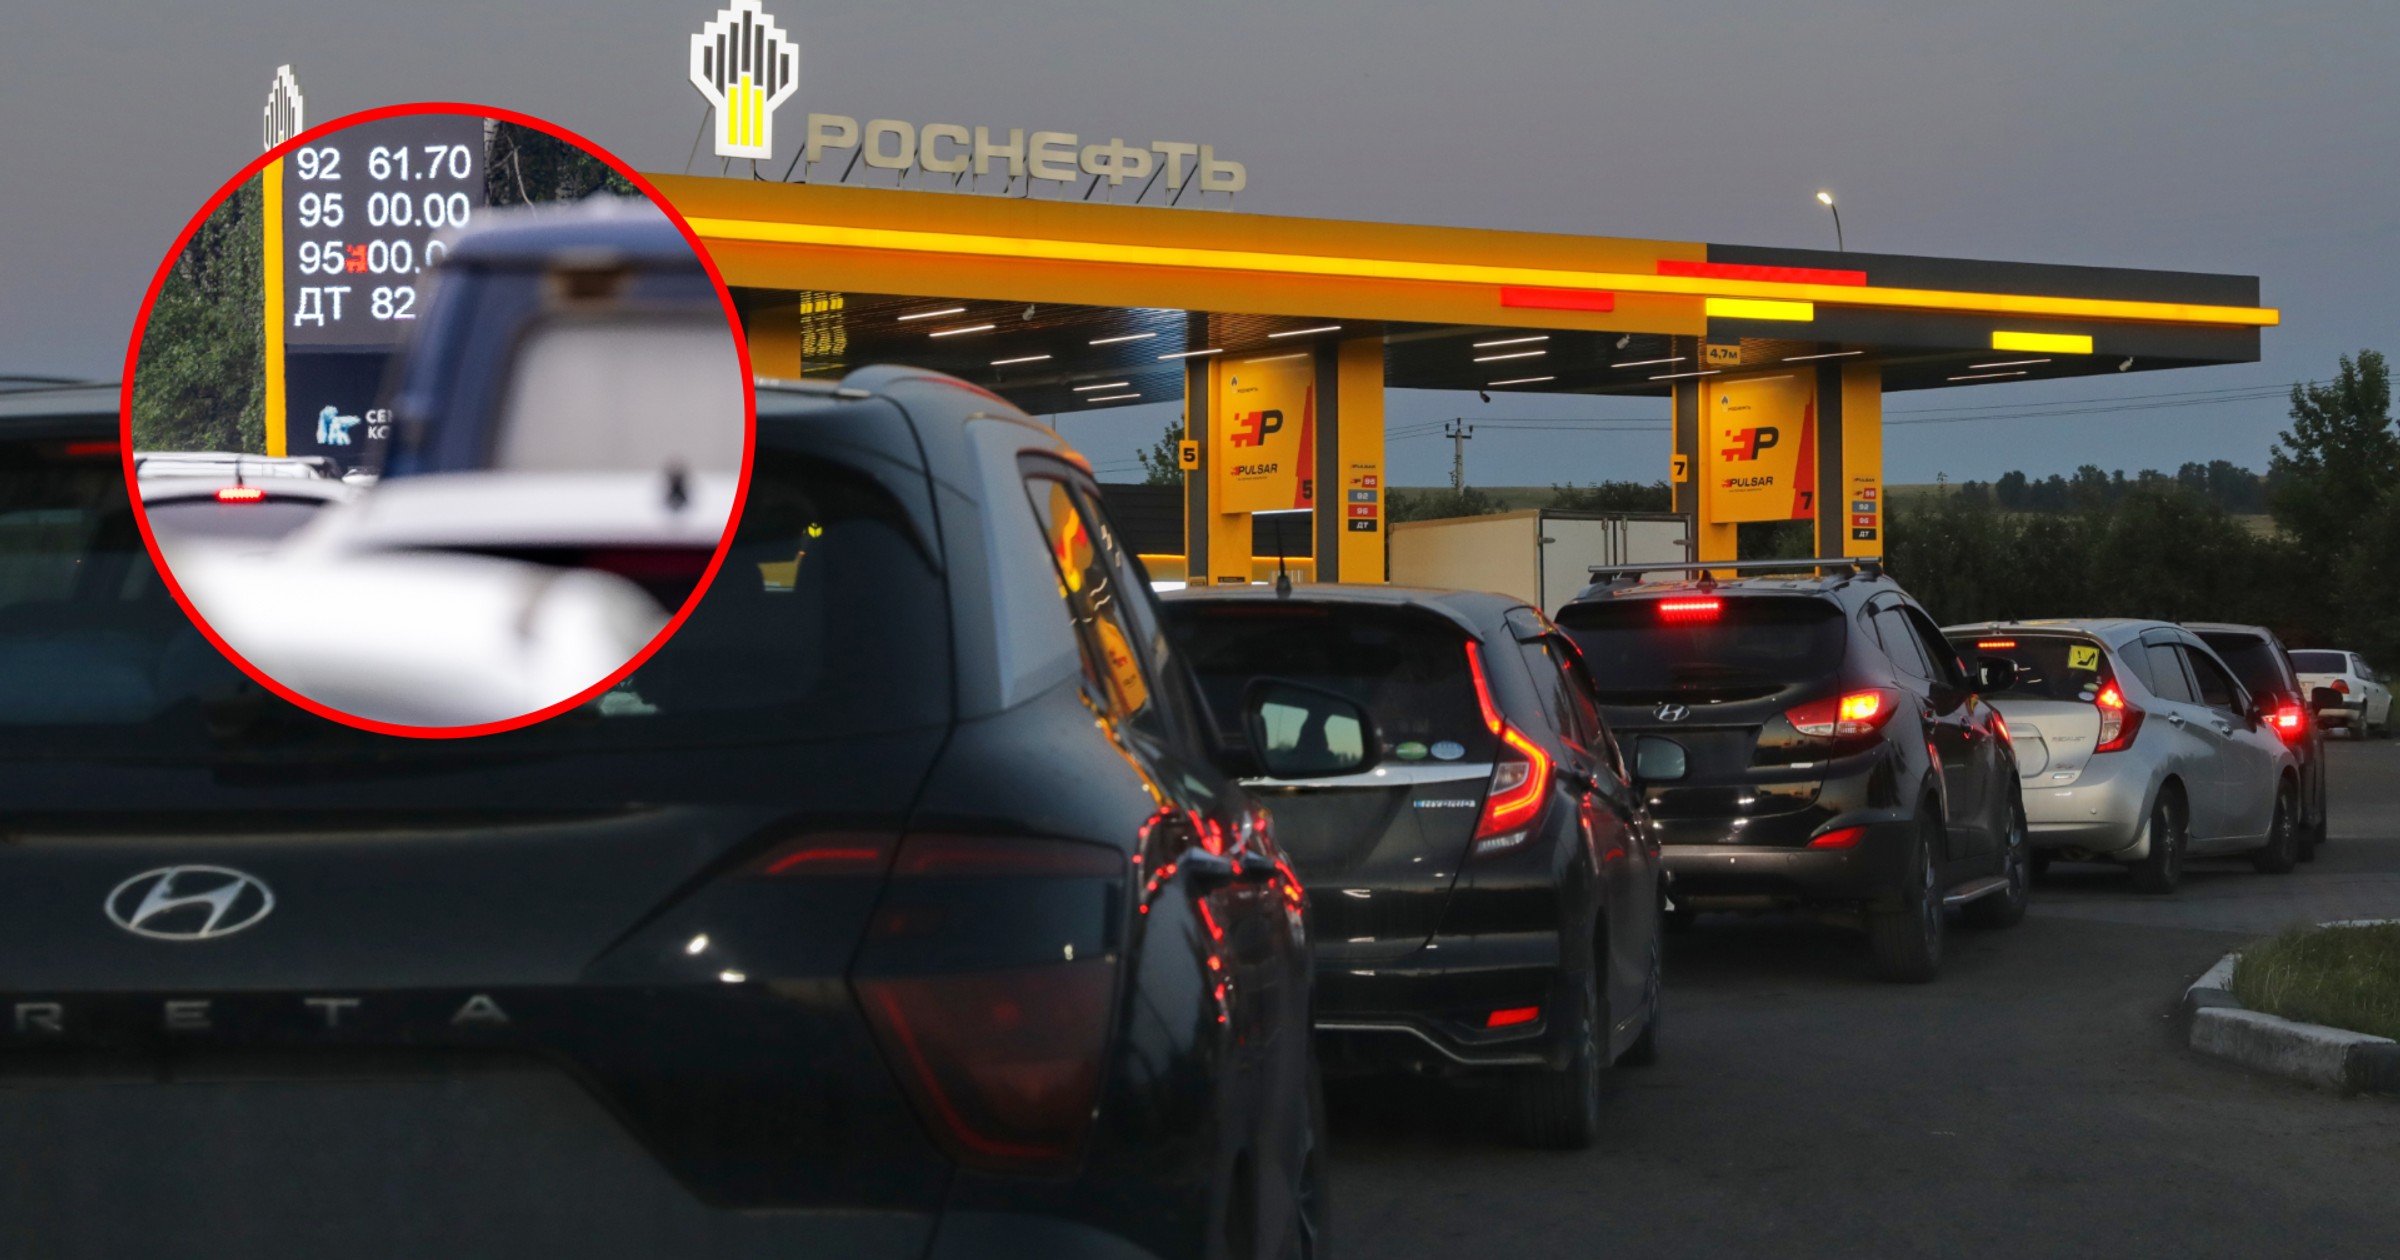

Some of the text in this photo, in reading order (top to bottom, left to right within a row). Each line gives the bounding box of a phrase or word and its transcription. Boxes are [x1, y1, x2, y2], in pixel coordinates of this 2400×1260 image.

[806, 113, 1246, 192] РОСНЕФТЬ
[297, 144, 471, 181] 92 61.70
[299, 191, 471, 228] 95 00.00
[299, 241, 345, 275] 95
[293, 286, 416, 327] ДТ 82
[365, 409, 392, 424] СЕ
[1183, 447, 1196, 463] 5
[1238, 463, 1278, 476] PULSAR
[1673, 461, 1686, 476] 7
[1302, 480, 1313, 499] 5
[1730, 476, 1774, 487] PULSAR
[1801, 491, 1813, 510] 7
[14, 994, 510, 1031] RETA
